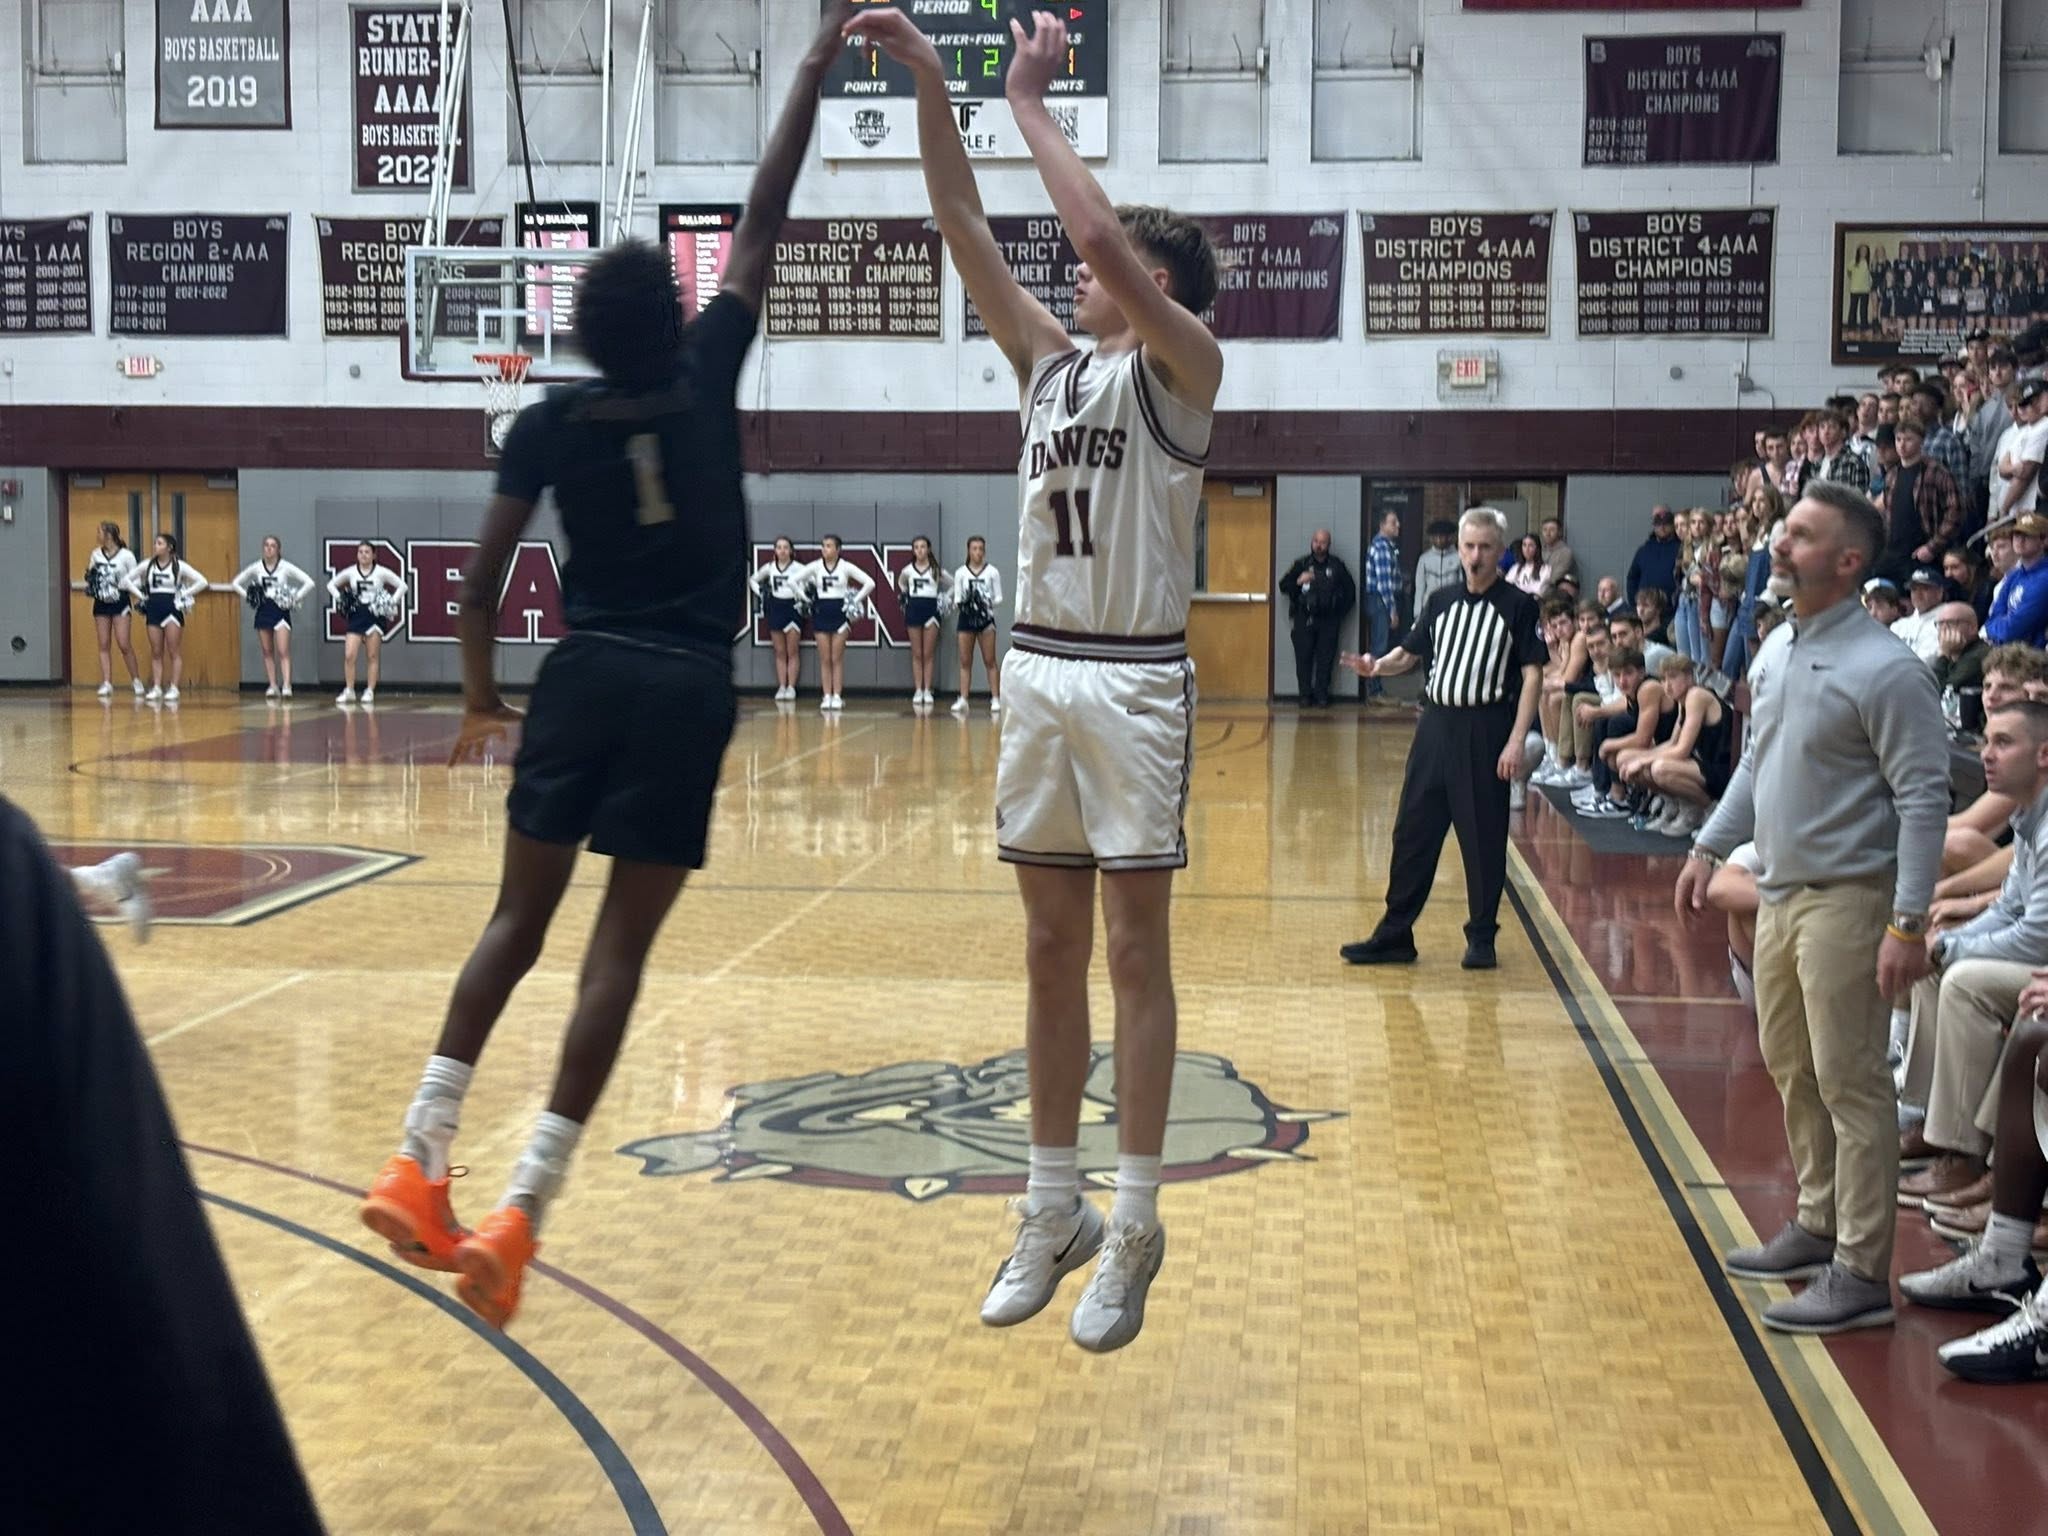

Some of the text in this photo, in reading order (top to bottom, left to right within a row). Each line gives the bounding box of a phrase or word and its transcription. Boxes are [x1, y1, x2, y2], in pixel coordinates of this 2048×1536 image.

[191, 0, 252, 22] AAA
[913, 0, 970, 14] PERIOD
[367, 14, 453, 43] STATE
[164, 36, 280, 61] BOYS BASKETBALL
[1666, 45, 1701, 64] BOYS
[359, 47, 458, 77] RUNNER-U
[871, 48, 878, 77] 1
[983, 48, 999, 77] 2
[844, 81, 887, 93] POINTS
[1049, 80, 1085, 92] OINTS
[1627, 68, 1738, 90] DISTRICT 4-AAA
[187, 75, 257, 107] 2019
[1645, 93, 1720, 113] CHAMPIONS
[362, 124, 462, 146] BOYS BASKET
[988, 134, 996, 149] F
[173, 220, 223, 239] BOYS
[678, 215, 722, 225] BULLDOGS
[1028, 220, 1063, 239] BOY
[1430, 217, 1483, 237] BOYS
[1646, 214, 1702, 234] BOYS
[0, 225, 26, 240] YS
[828, 222, 879, 241] BOYS
[1233, 223, 1267, 242] BOYS
[0, 244, 29, 262] AL
[48, 241, 82, 262] AAA
[126, 242, 269, 262] REGION 2-AAA
[775, 242, 930, 263] DISTRICT 4-AAA
[997, 242, 1060, 261] TRICT
[1375, 238, 1536, 258] DISTRICT 4-AAA
[1589, 234, 1759, 258] DISTRICT 4-AAA
[1261, 247, 1301, 266] 4-AAA
[35, 264, 84, 278] 2000-2001
[162, 263, 235, 283] CHAMPIONS
[773, 264, 933, 284] TOURNAMENT CHAMPIONS
[1400, 260, 1512, 281] CHAMPIONS
[1615, 257, 1732, 279] CHAMPIONS
[1257, 270, 1328, 289] CHAMPIONS
[324, 284, 376, 299] 1992-1993
[828, 286, 880, 300] 1992-1993
[828, 302, 882, 316] 1993-1994
[888, 318, 939, 332] 2001-2002
[129, 356, 150, 374] EXIT
[1456, 358, 1479, 377] EXIT
[624, 433, 675, 525] 1
[1049, 489, 1094, 556] 11
[152, 573, 170, 588] F
[773, 575, 788, 592] F
[822, 576, 839, 592] F
[913, 578, 930, 594] F
